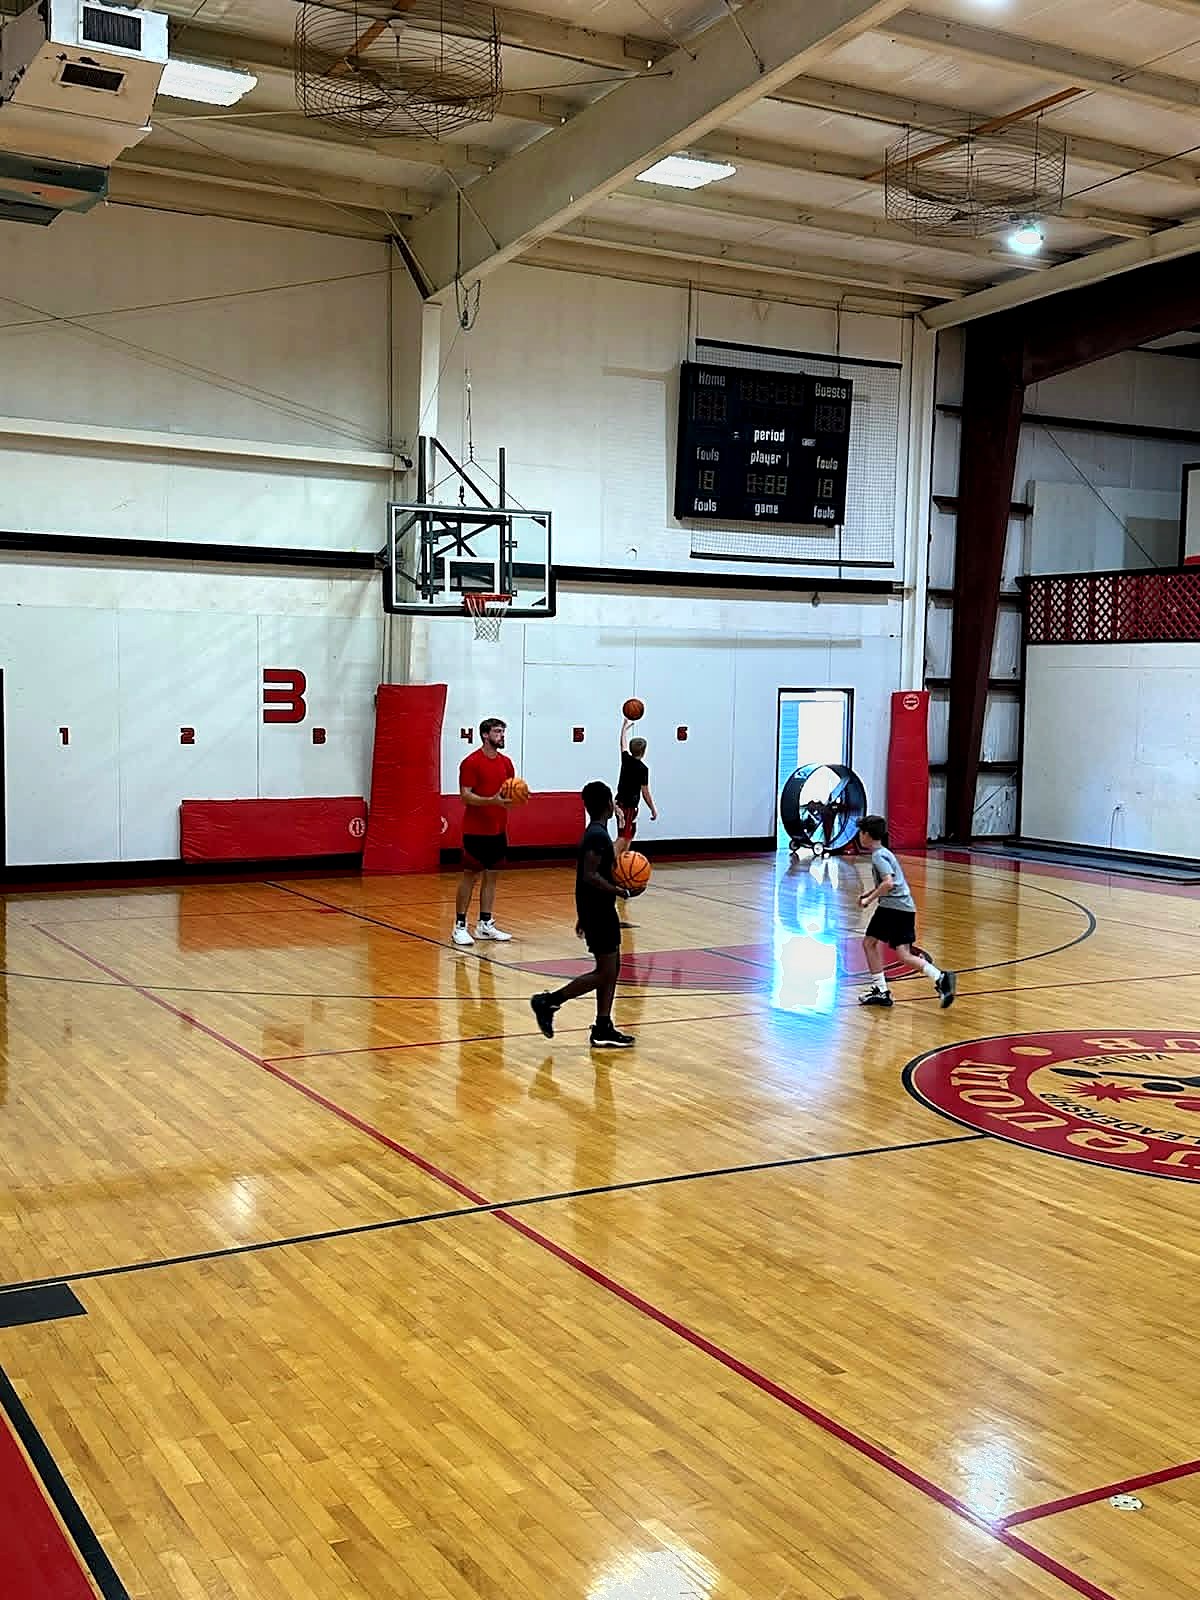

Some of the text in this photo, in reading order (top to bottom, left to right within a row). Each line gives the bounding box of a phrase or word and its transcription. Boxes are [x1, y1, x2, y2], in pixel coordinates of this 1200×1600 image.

[698, 371, 726, 387] Home
[815, 383, 847, 399] Guests
[753, 429, 785, 443] period
[696, 447, 719, 461] fouls
[750, 449, 782, 467] player
[816, 456, 838, 470] fouls
[694, 498, 717, 512] fouls
[754, 503, 779, 516] game
[813, 505, 836, 519] fouls
[58, 727, 70, 745] 1
[180, 727, 195, 745] 2
[460, 727, 474, 744] 4
[572, 727, 586, 743] 5
[676, 726, 689, 742] 6
[1073, 1053, 1175, 1066] VALUES
